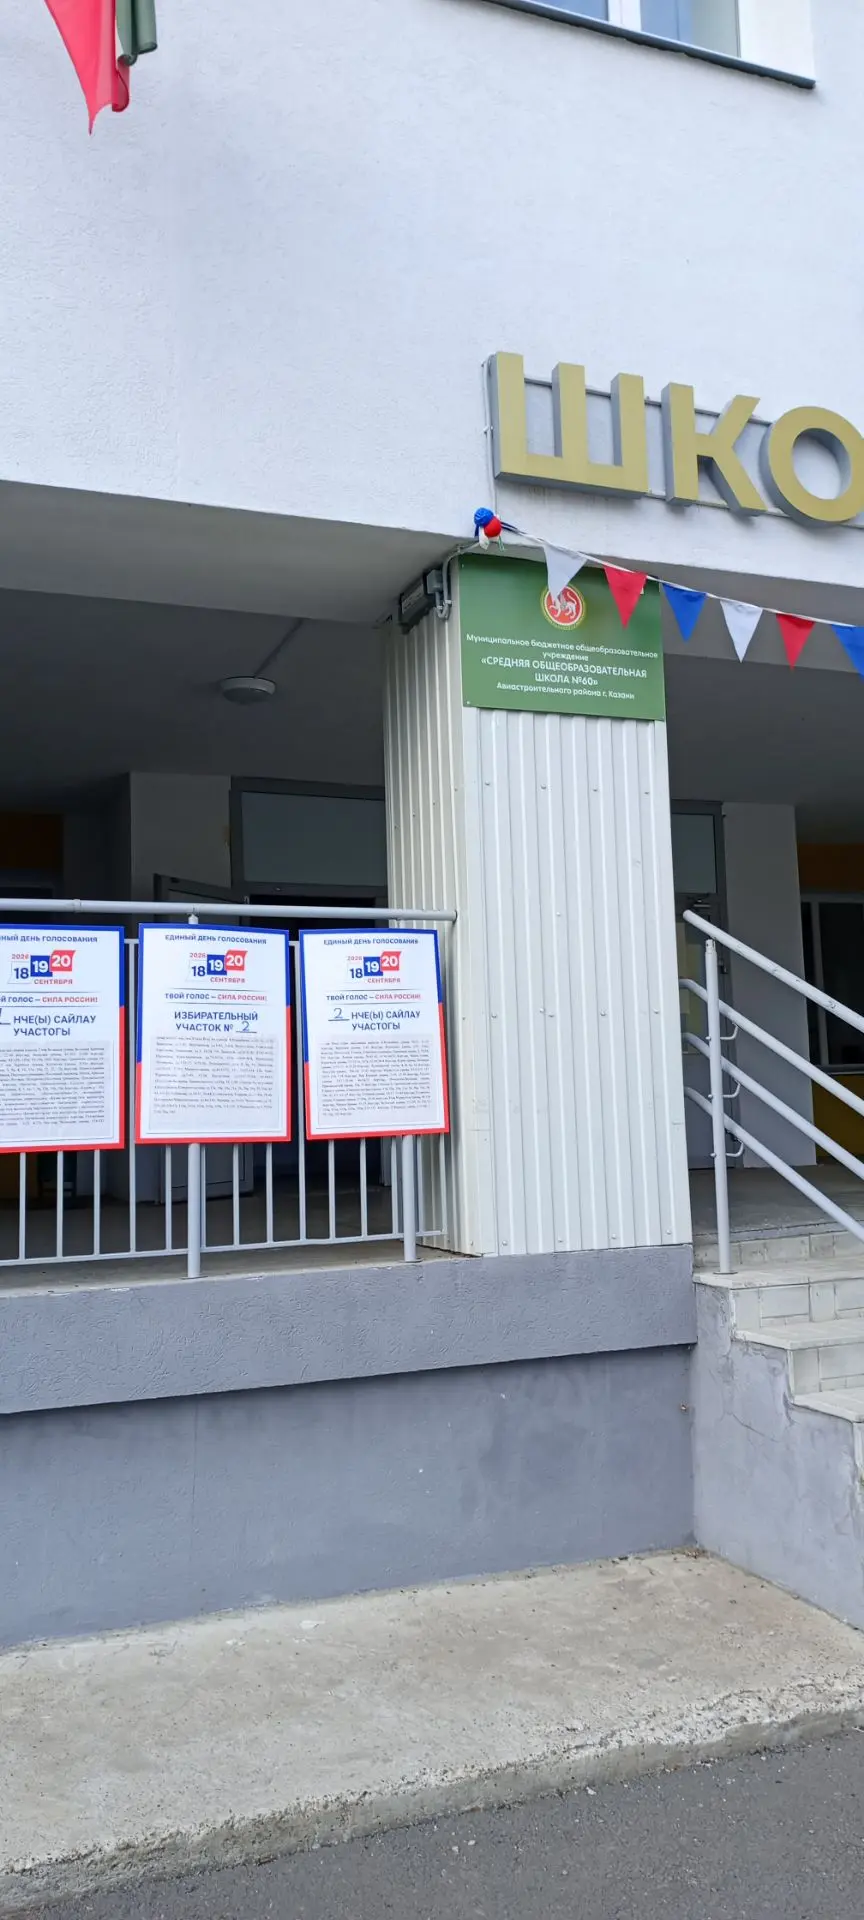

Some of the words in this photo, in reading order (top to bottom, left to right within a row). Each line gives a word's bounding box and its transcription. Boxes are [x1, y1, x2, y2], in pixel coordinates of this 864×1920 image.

[466, 633, 530, 647] Муниципальное
[531, 639, 575, 651] бюджетное
[575, 643, 658, 659] общеобразовательное
[542, 651, 589, 662] учреждение
[481, 656, 530, 668] «СРЕДНЯЯ
[532, 660, 647, 678] ОБЩЕОБРАЗОВАТЕЛЬНАЯ
[535, 673, 570, 684] ШКОЛА
[572, 675, 599, 686] №60»
[496, 682, 572, 695] Авиастроительного
[573, 688, 602, 698] района
[608, 691, 635, 700] Казани
[20, 935, 41, 943] ДЕНЬ
[42, 935, 98, 943] ГОЛОСОВАНИЯ
[217, 936, 267, 945] ГОЛОСОВАНИЯ
[372, 937, 419, 945] ГОЛОСОВАНИЯ
[13, 967, 29, 980] 18
[32, 960, 49, 973] 19
[51, 954, 72, 968] 20
[191, 966, 206, 977] 18
[208, 959, 224, 971] 19
[226, 954, 244, 967] 20
[349, 968, 363, 979] 18
[365, 960, 380, 973] 19
[381, 955, 398, 967] 20
[13, 1015, 51, 1025] НЧЕ(Ы)
[53, 1013, 97, 1024] САЙЛАУ
[174, 1011, 258, 1021] ИЗБИРАТЕЛЬНЫЙ
[333, 1007, 343, 1019] 2
[351, 1011, 384, 1021] НЧЕ(Ы)
[385, 1009, 421, 1019] САЙЛАУ
[13, 1027, 71, 1036] УЧАСТОГЫ
[175, 1023, 222, 1032] УЧАСТОК
[223, 1023, 234, 1032] №
[241, 1020, 251, 1032] 2
[351, 1022, 401, 1032] УЧАСТОГЫ
